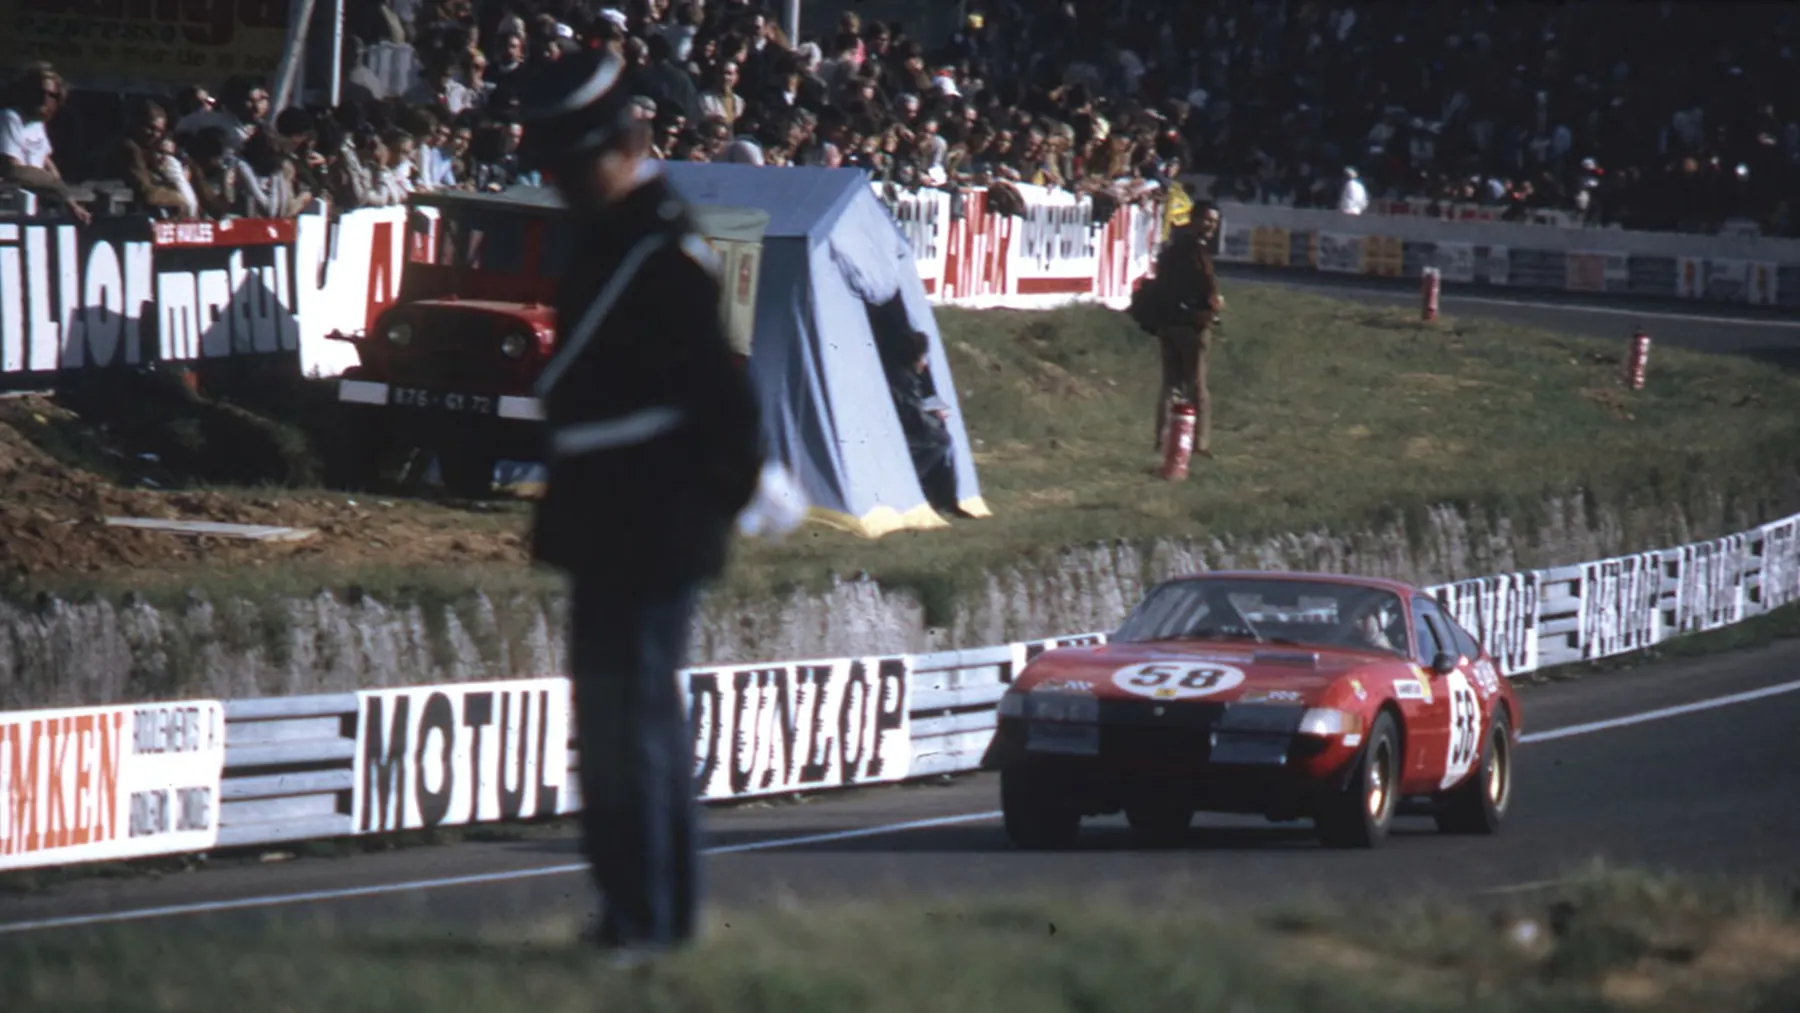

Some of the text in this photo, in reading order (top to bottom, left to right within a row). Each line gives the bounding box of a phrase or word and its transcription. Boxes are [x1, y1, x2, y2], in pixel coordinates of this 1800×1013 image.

[692, 661, 906, 798] DUNLOP
[1130, 664, 1226, 689] 58
[1452, 690, 1473, 765] 58
[361, 691, 559, 829] MOTUL
